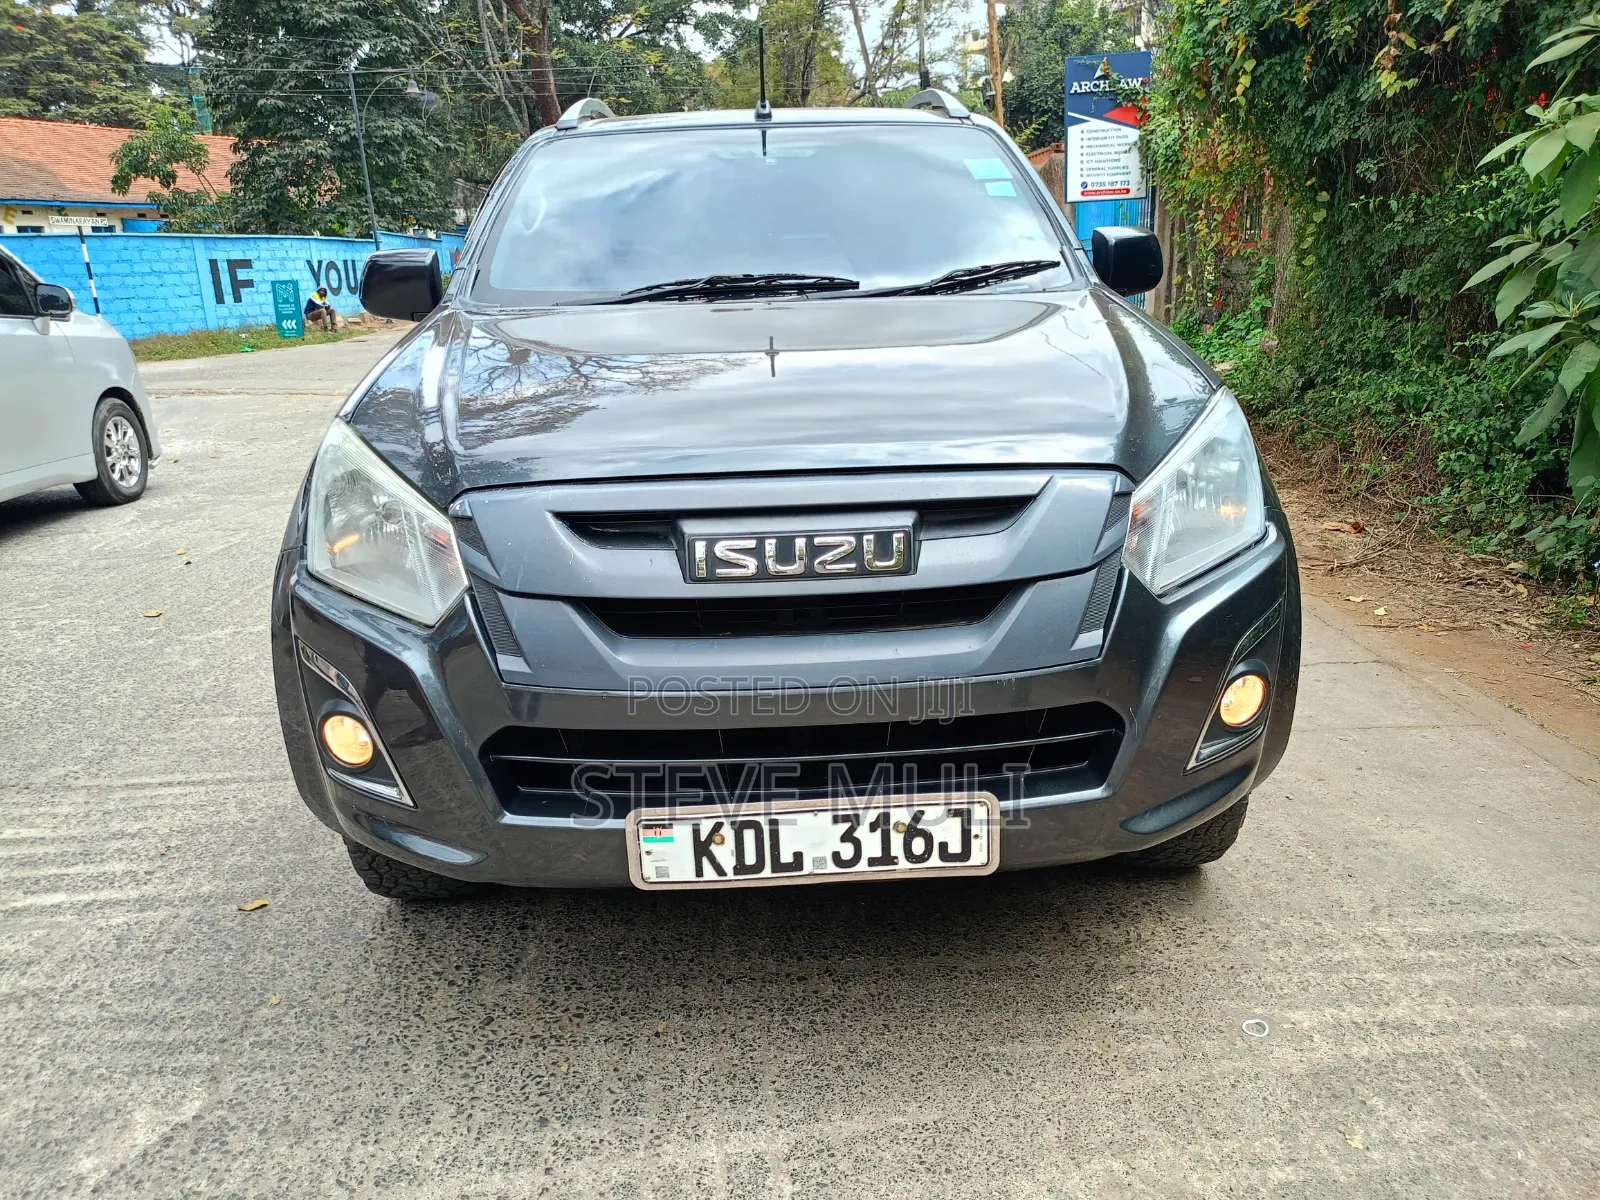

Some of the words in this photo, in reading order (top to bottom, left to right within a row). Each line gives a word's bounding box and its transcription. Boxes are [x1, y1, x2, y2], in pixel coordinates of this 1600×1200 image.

[208, 258, 255, 305] IF
[306, 259, 359, 297] YOU
[694, 531, 906, 578] ISUZU
[692, 817, 804, 878] KDL
[831, 807, 972, 869] 316J
